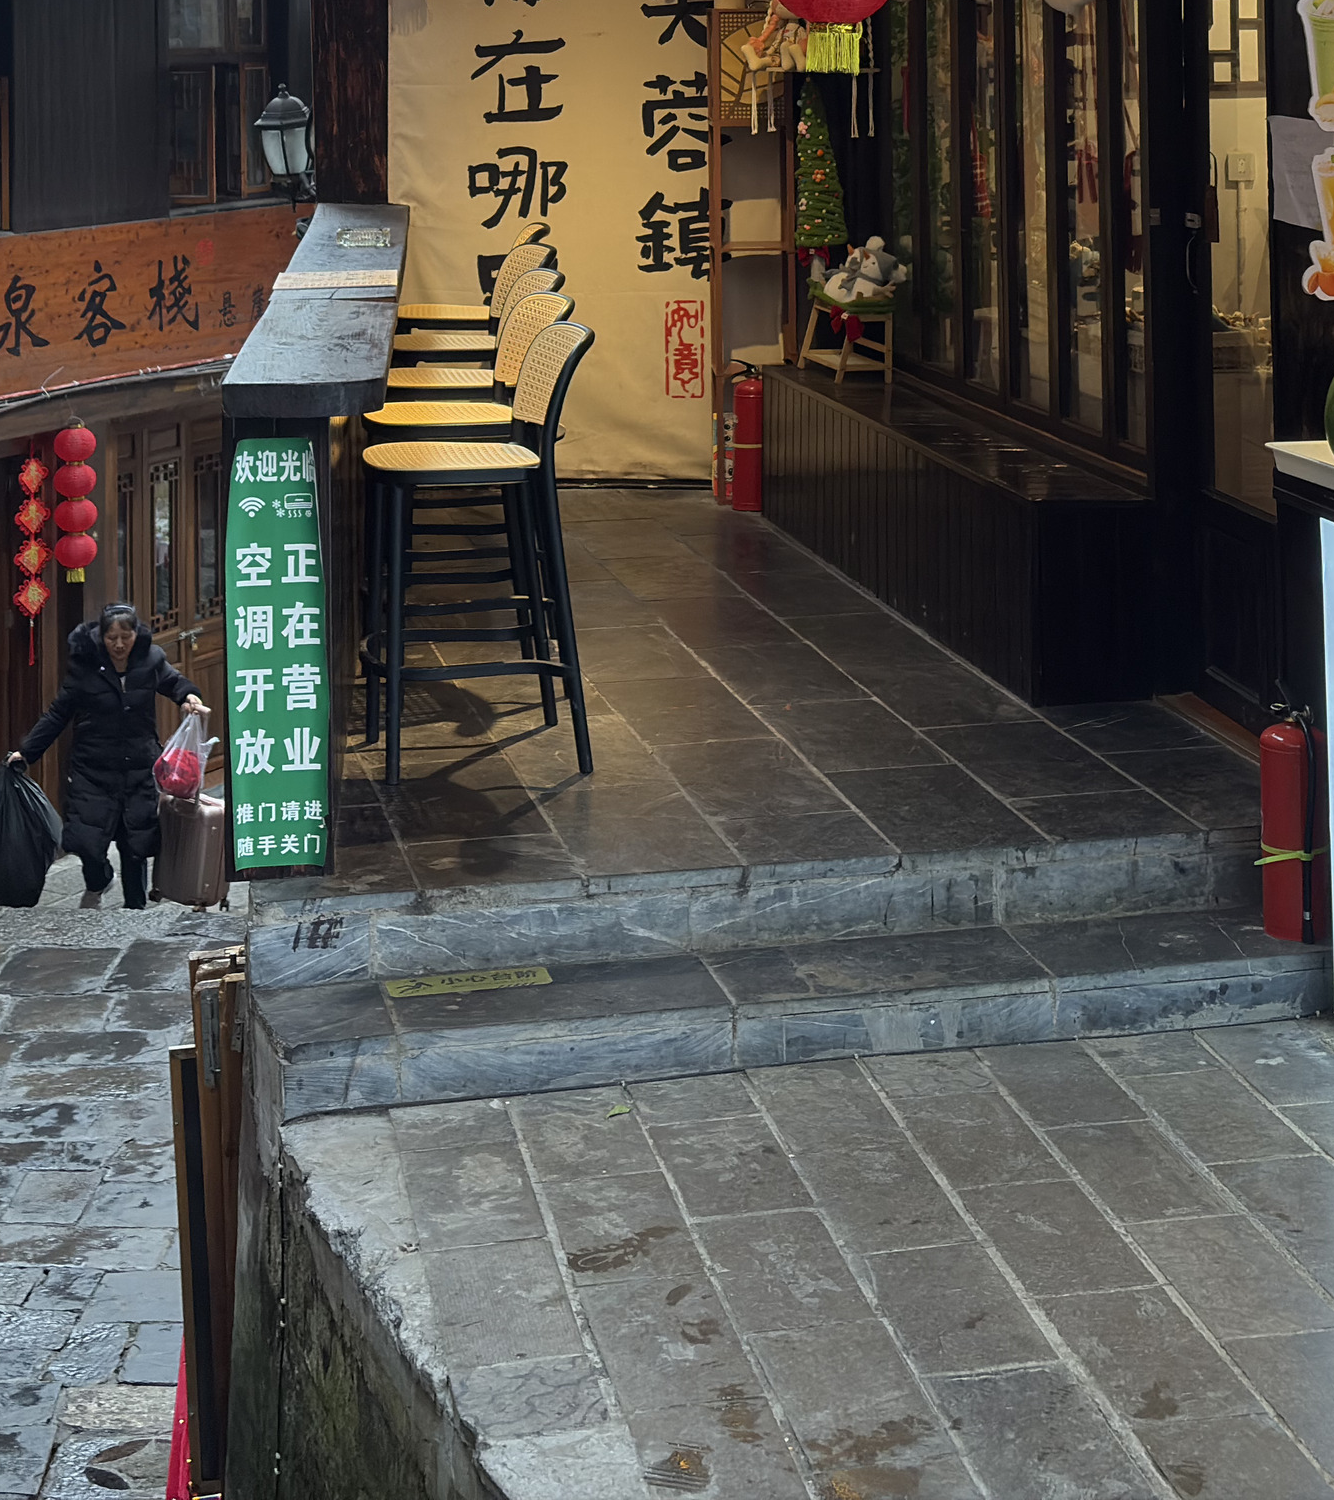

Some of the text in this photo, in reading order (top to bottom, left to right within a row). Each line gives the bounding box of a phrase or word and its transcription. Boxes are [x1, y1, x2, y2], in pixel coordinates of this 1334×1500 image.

[235, 449, 316, 484] 欢迎光临
[236, 800, 323, 824] 推门请进
[237, 834, 321, 858] 随手关门
